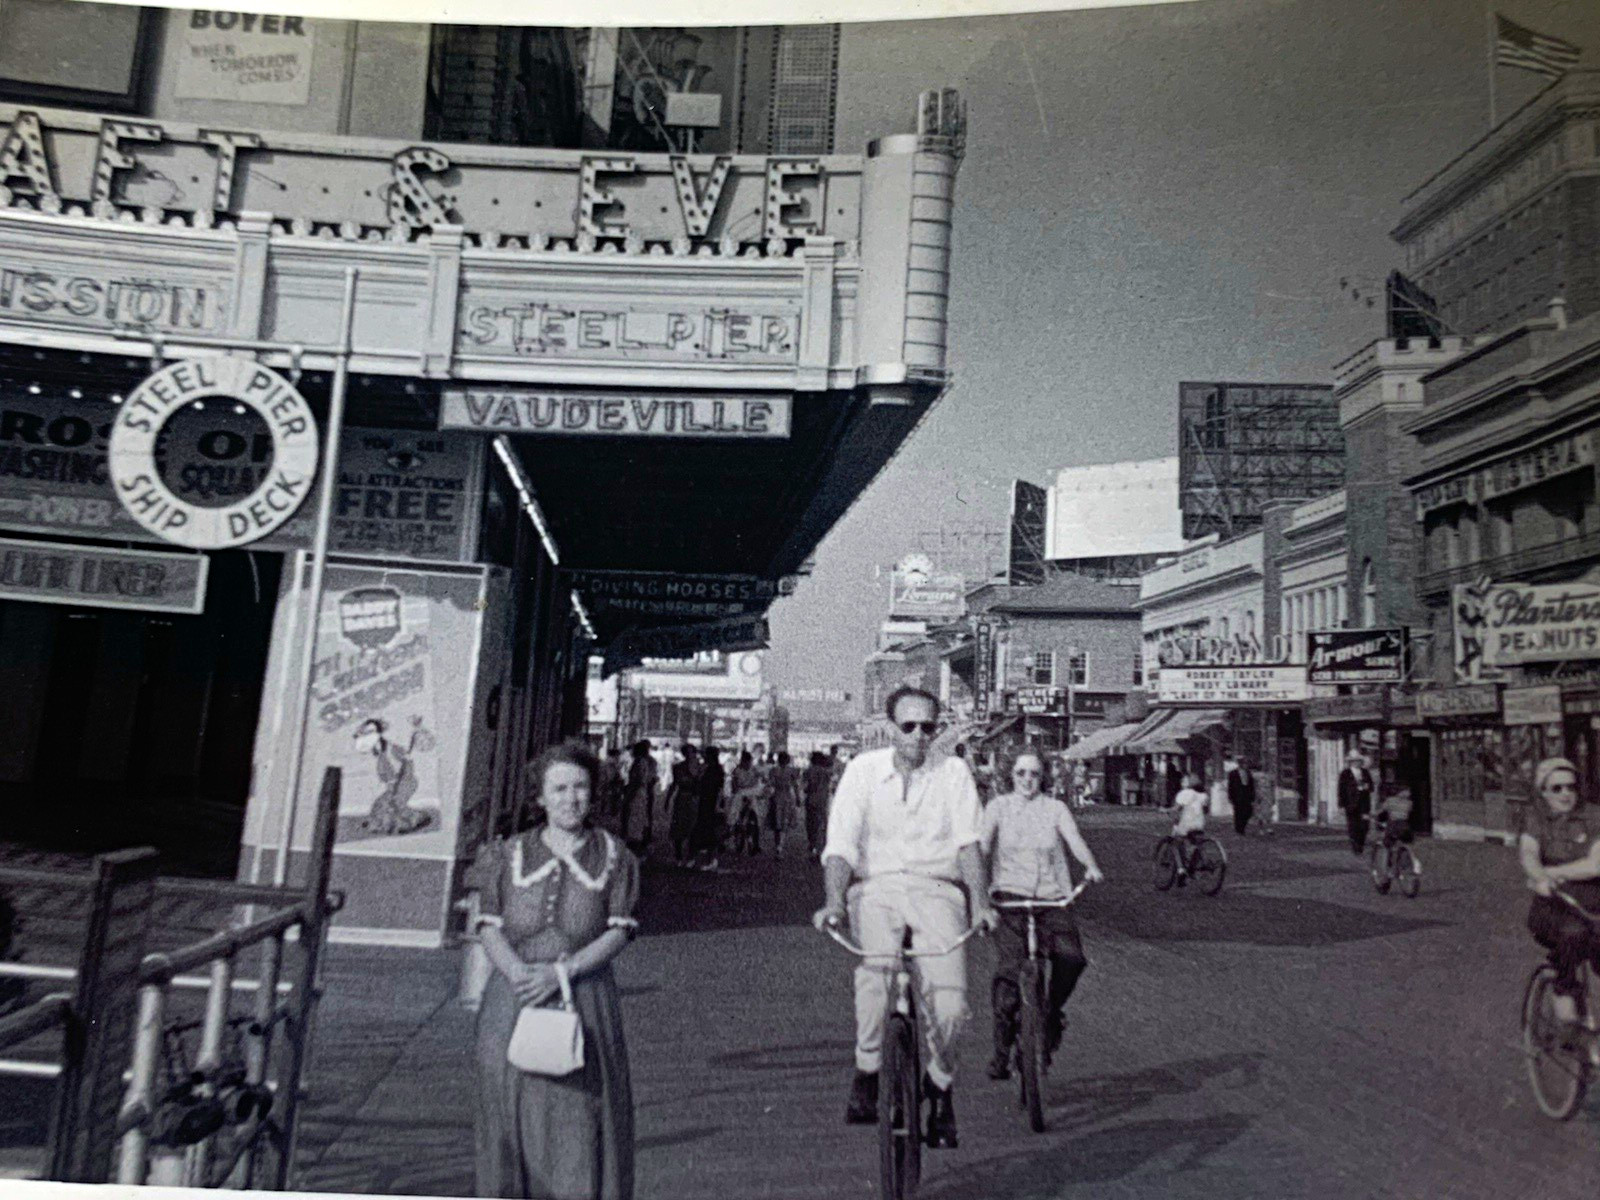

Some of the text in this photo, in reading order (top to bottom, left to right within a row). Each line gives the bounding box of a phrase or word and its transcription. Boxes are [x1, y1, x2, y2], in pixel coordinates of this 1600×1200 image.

[190, 9, 306, 36] BOYER
[237, 69, 295, 85] COMES
[578, 155, 822, 239] EVE
[468, 305, 792, 354] STEEL PIER
[125, 363, 307, 439] STEEL PIER
[462, 394, 773, 434] VAUDEVILLE
[121, 473, 189, 531] SHIP
[228, 472, 303, 539] DECK
[336, 488, 456, 522] FREE
[665, 581, 750, 600] HORSES
[1158, 634, 1291, 666] STRAND
[1186, 671, 1274, 679] ROBERT TAYLOR
